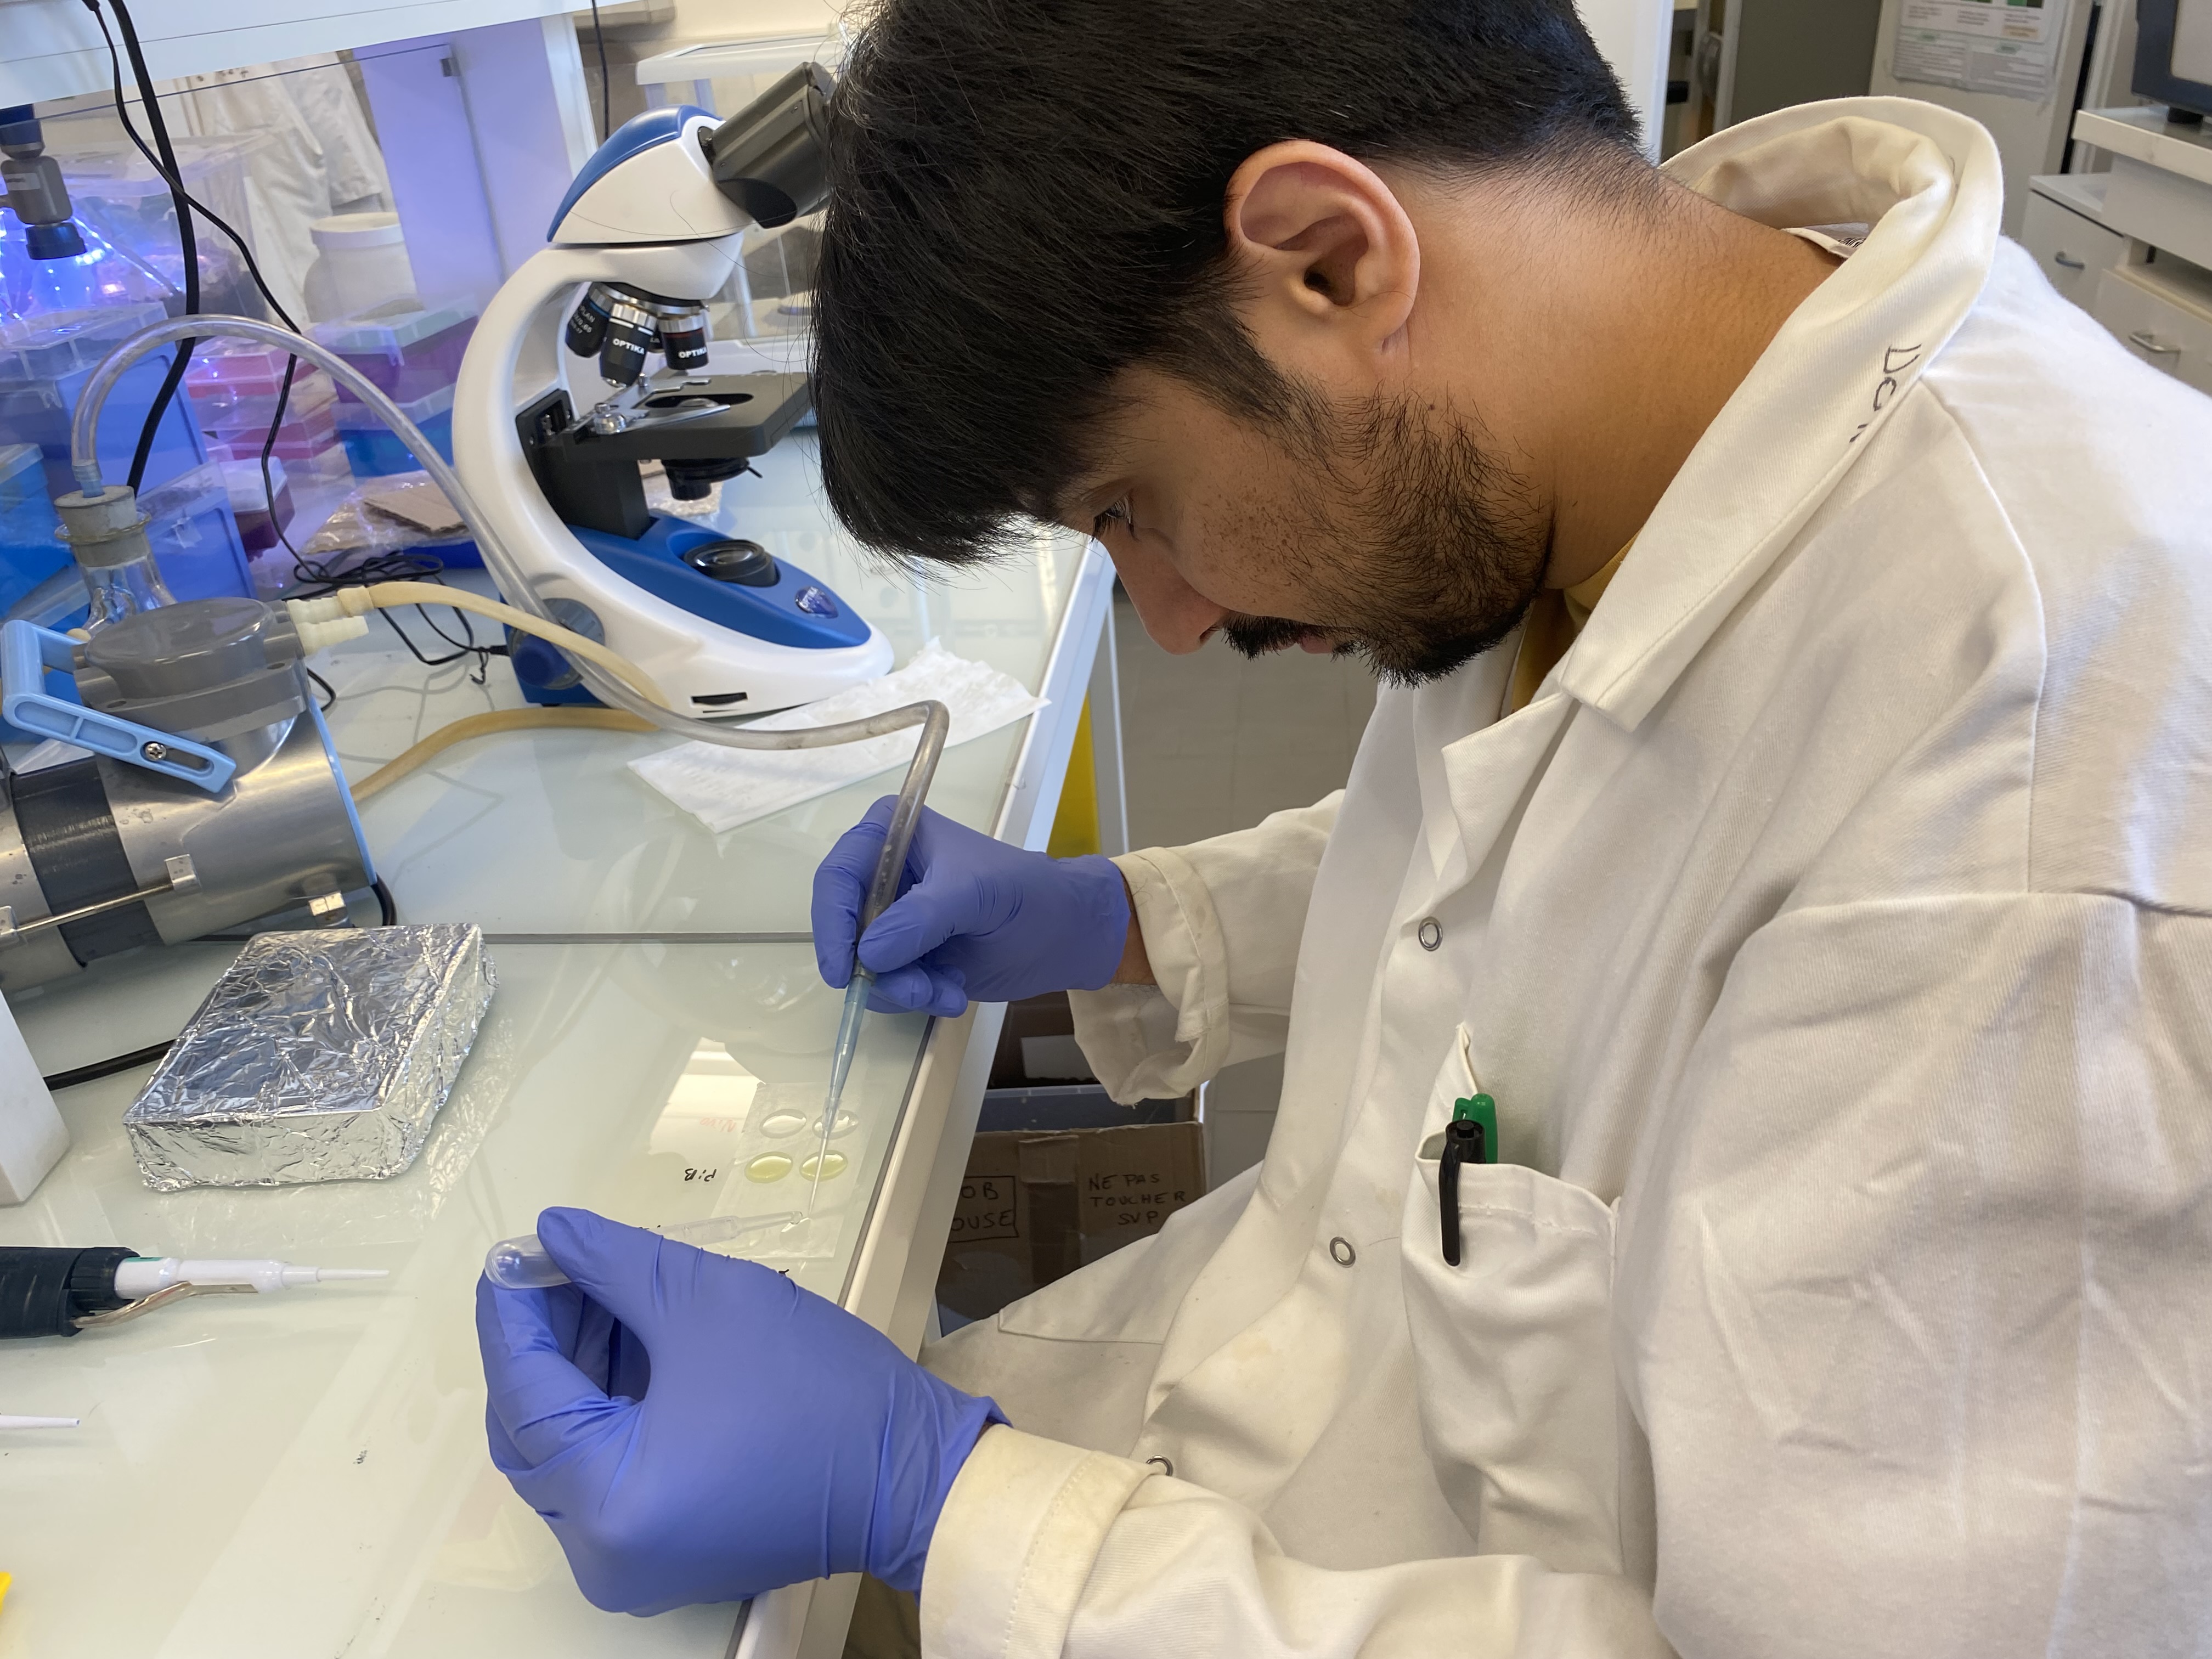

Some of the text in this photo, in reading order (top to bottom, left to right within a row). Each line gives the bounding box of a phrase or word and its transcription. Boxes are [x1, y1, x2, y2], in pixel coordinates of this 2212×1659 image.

[612, 338, 645, 355] OPTIKA
[1088, 1173, 1160, 1191] NE PAS
[962, 1182, 998, 1200] OB
[1090, 1190, 1186, 1207] TOUCHER
[951, 1209, 1013, 1232] OUSE
[1118, 1210, 1159, 1226] SVP
